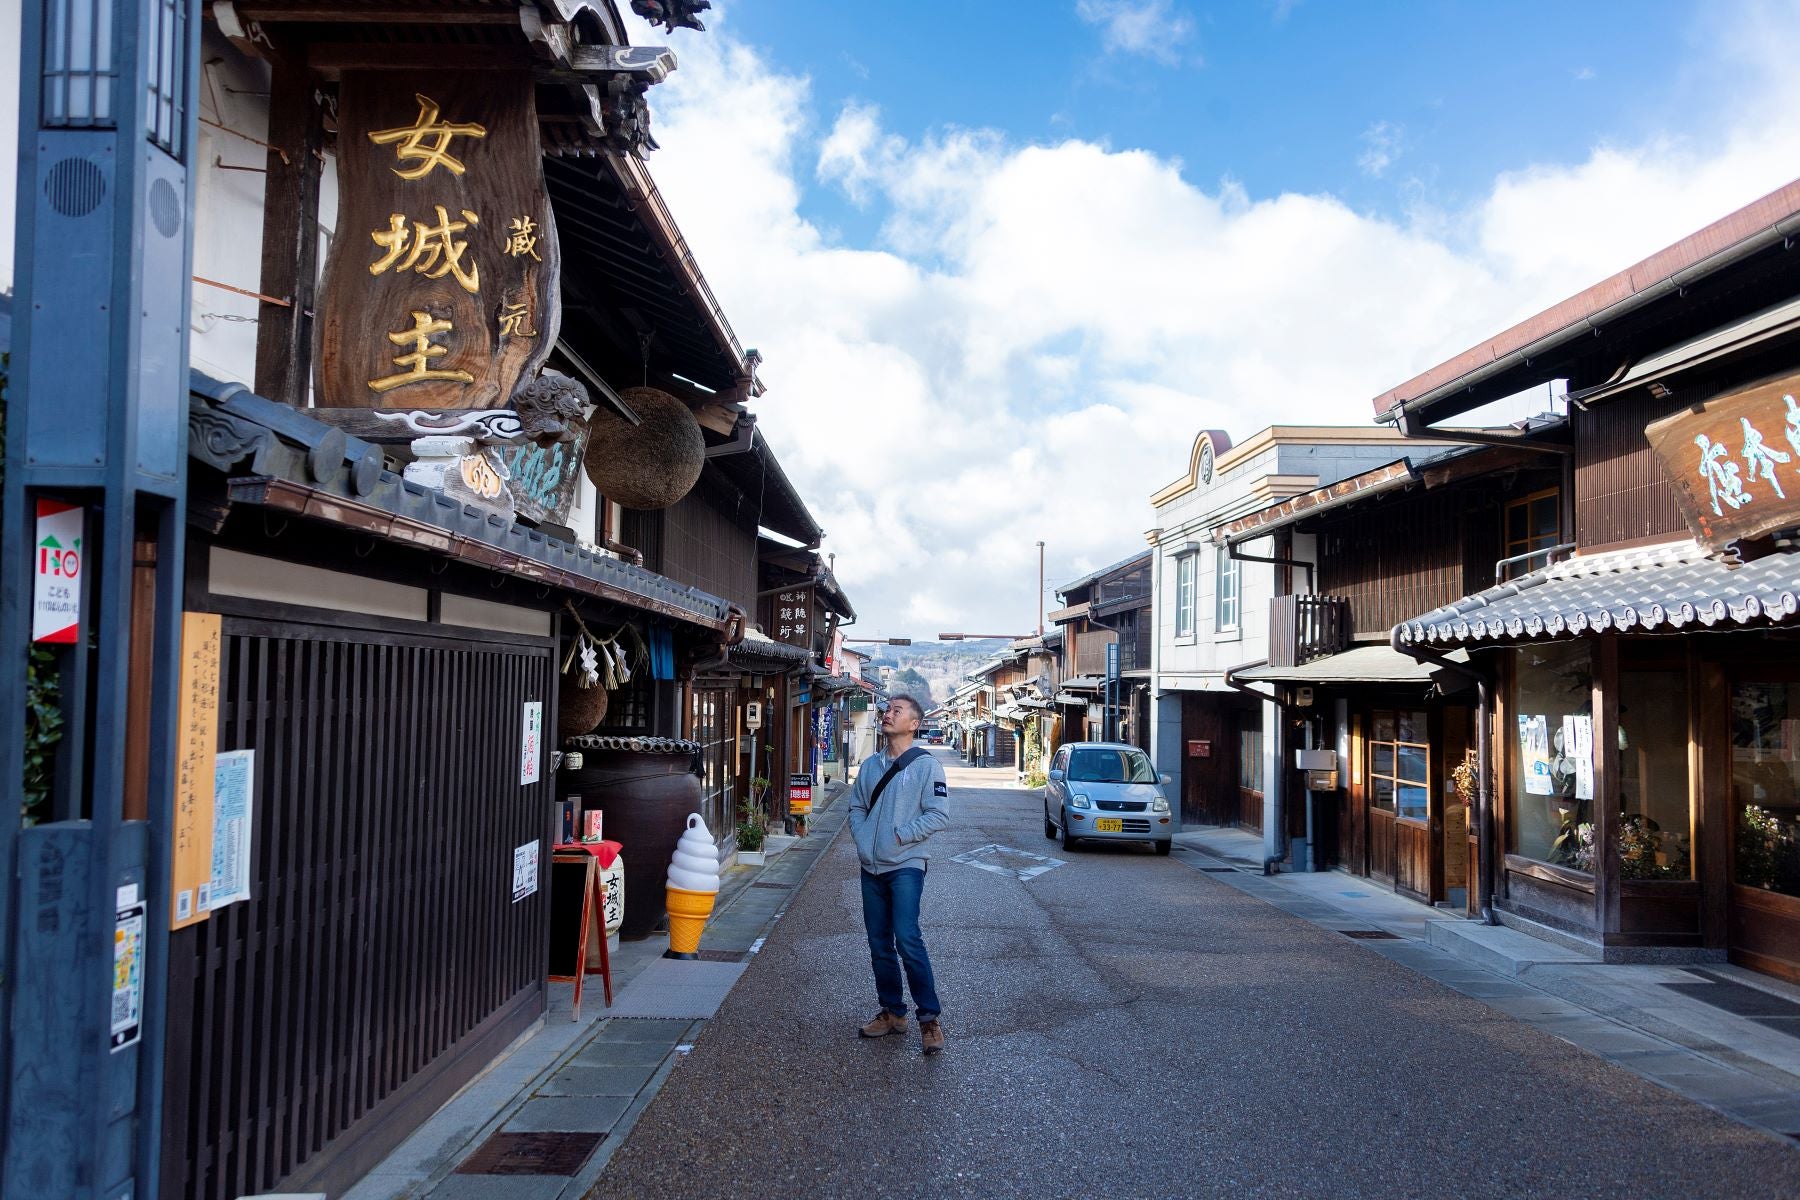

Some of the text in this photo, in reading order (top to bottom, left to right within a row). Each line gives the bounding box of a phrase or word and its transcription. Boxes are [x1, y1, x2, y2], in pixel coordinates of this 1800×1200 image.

[368, 93, 487, 392] 女城主
[500, 215, 542, 338] 蔵元
[606, 873, 619, 924] 女城主
